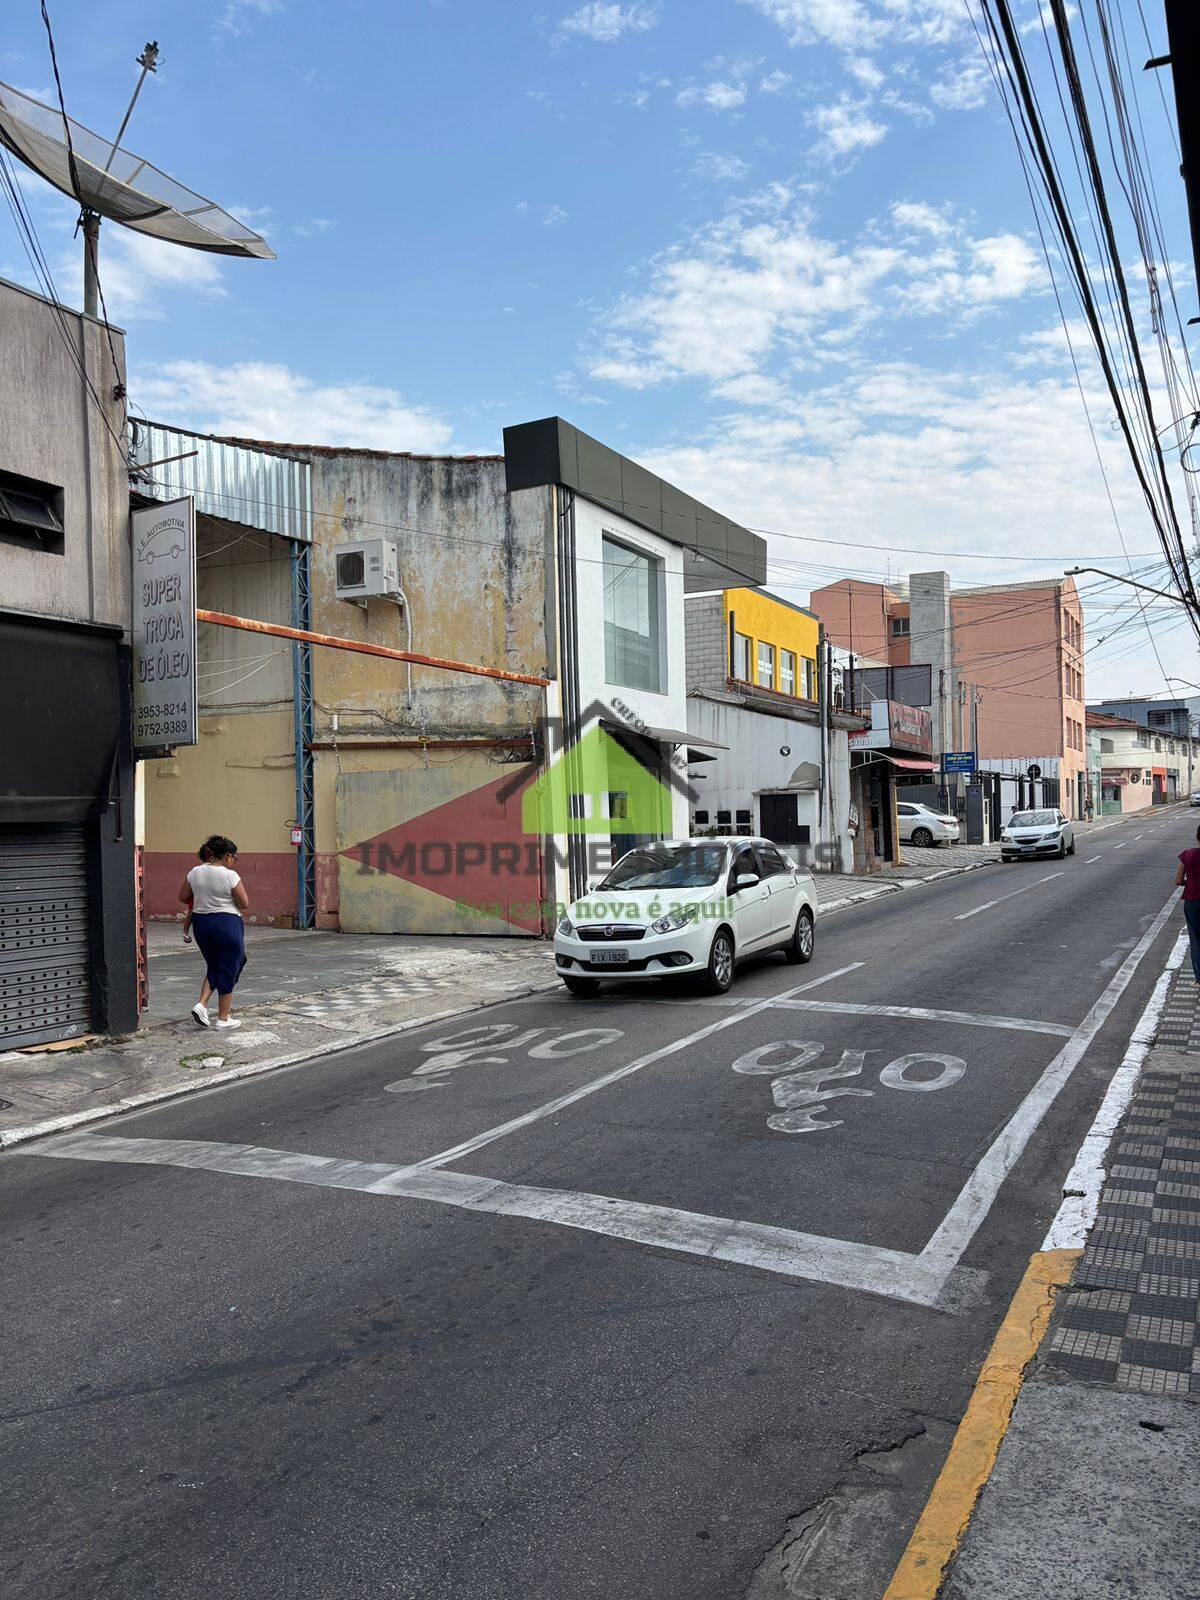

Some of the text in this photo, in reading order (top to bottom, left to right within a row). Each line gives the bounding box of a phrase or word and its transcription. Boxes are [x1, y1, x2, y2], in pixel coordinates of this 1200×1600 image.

[146, 518, 185, 539] AUTOMOTIVA
[142, 573, 181, 607] SUPER
[143, 611, 184, 645] TROCA
[138, 648, 190, 683] DE ÓLEO
[138, 701, 187, 720] 3953-8214
[138, 719, 187, 737] 9752-9389
